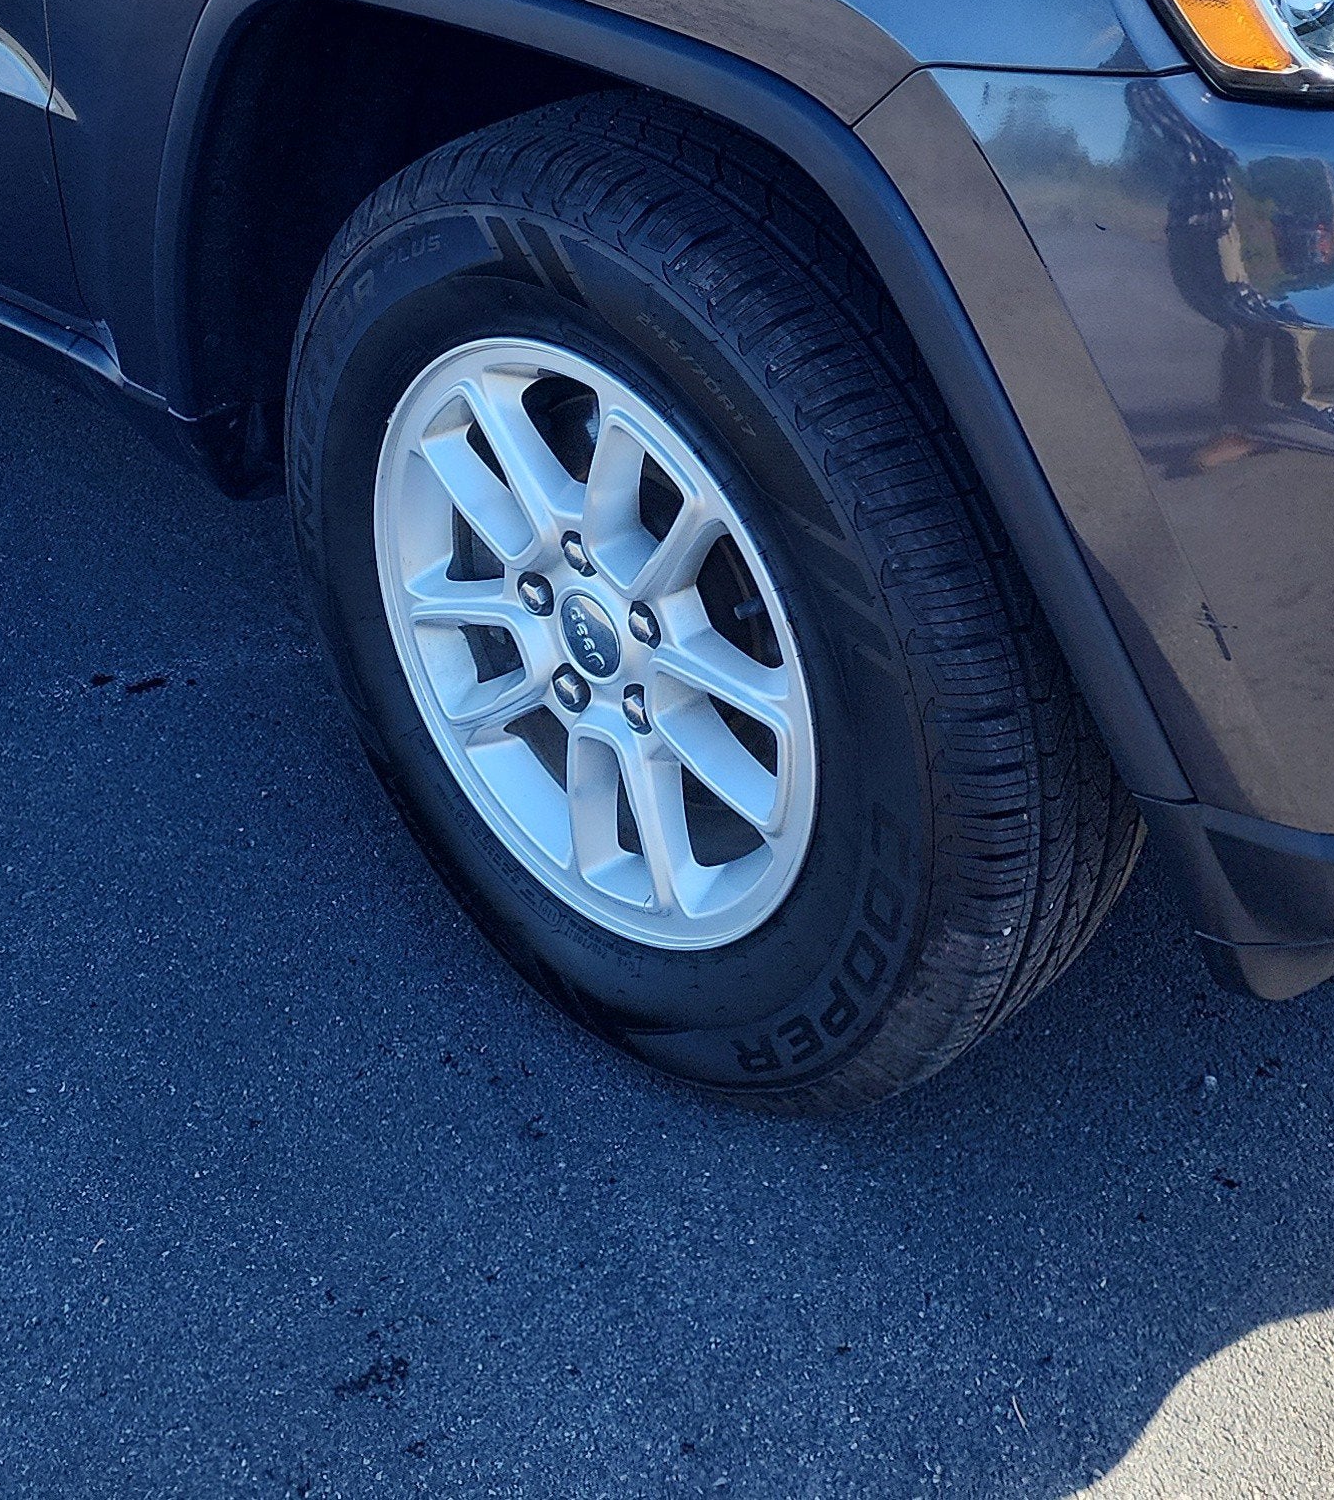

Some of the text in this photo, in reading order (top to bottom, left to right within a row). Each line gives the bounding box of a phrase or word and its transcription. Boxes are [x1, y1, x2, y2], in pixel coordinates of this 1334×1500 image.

[382, 232, 442, 274] PLUS
[570, 605, 606, 670] Jeep
[729, 800, 913, 1075] COOPER
